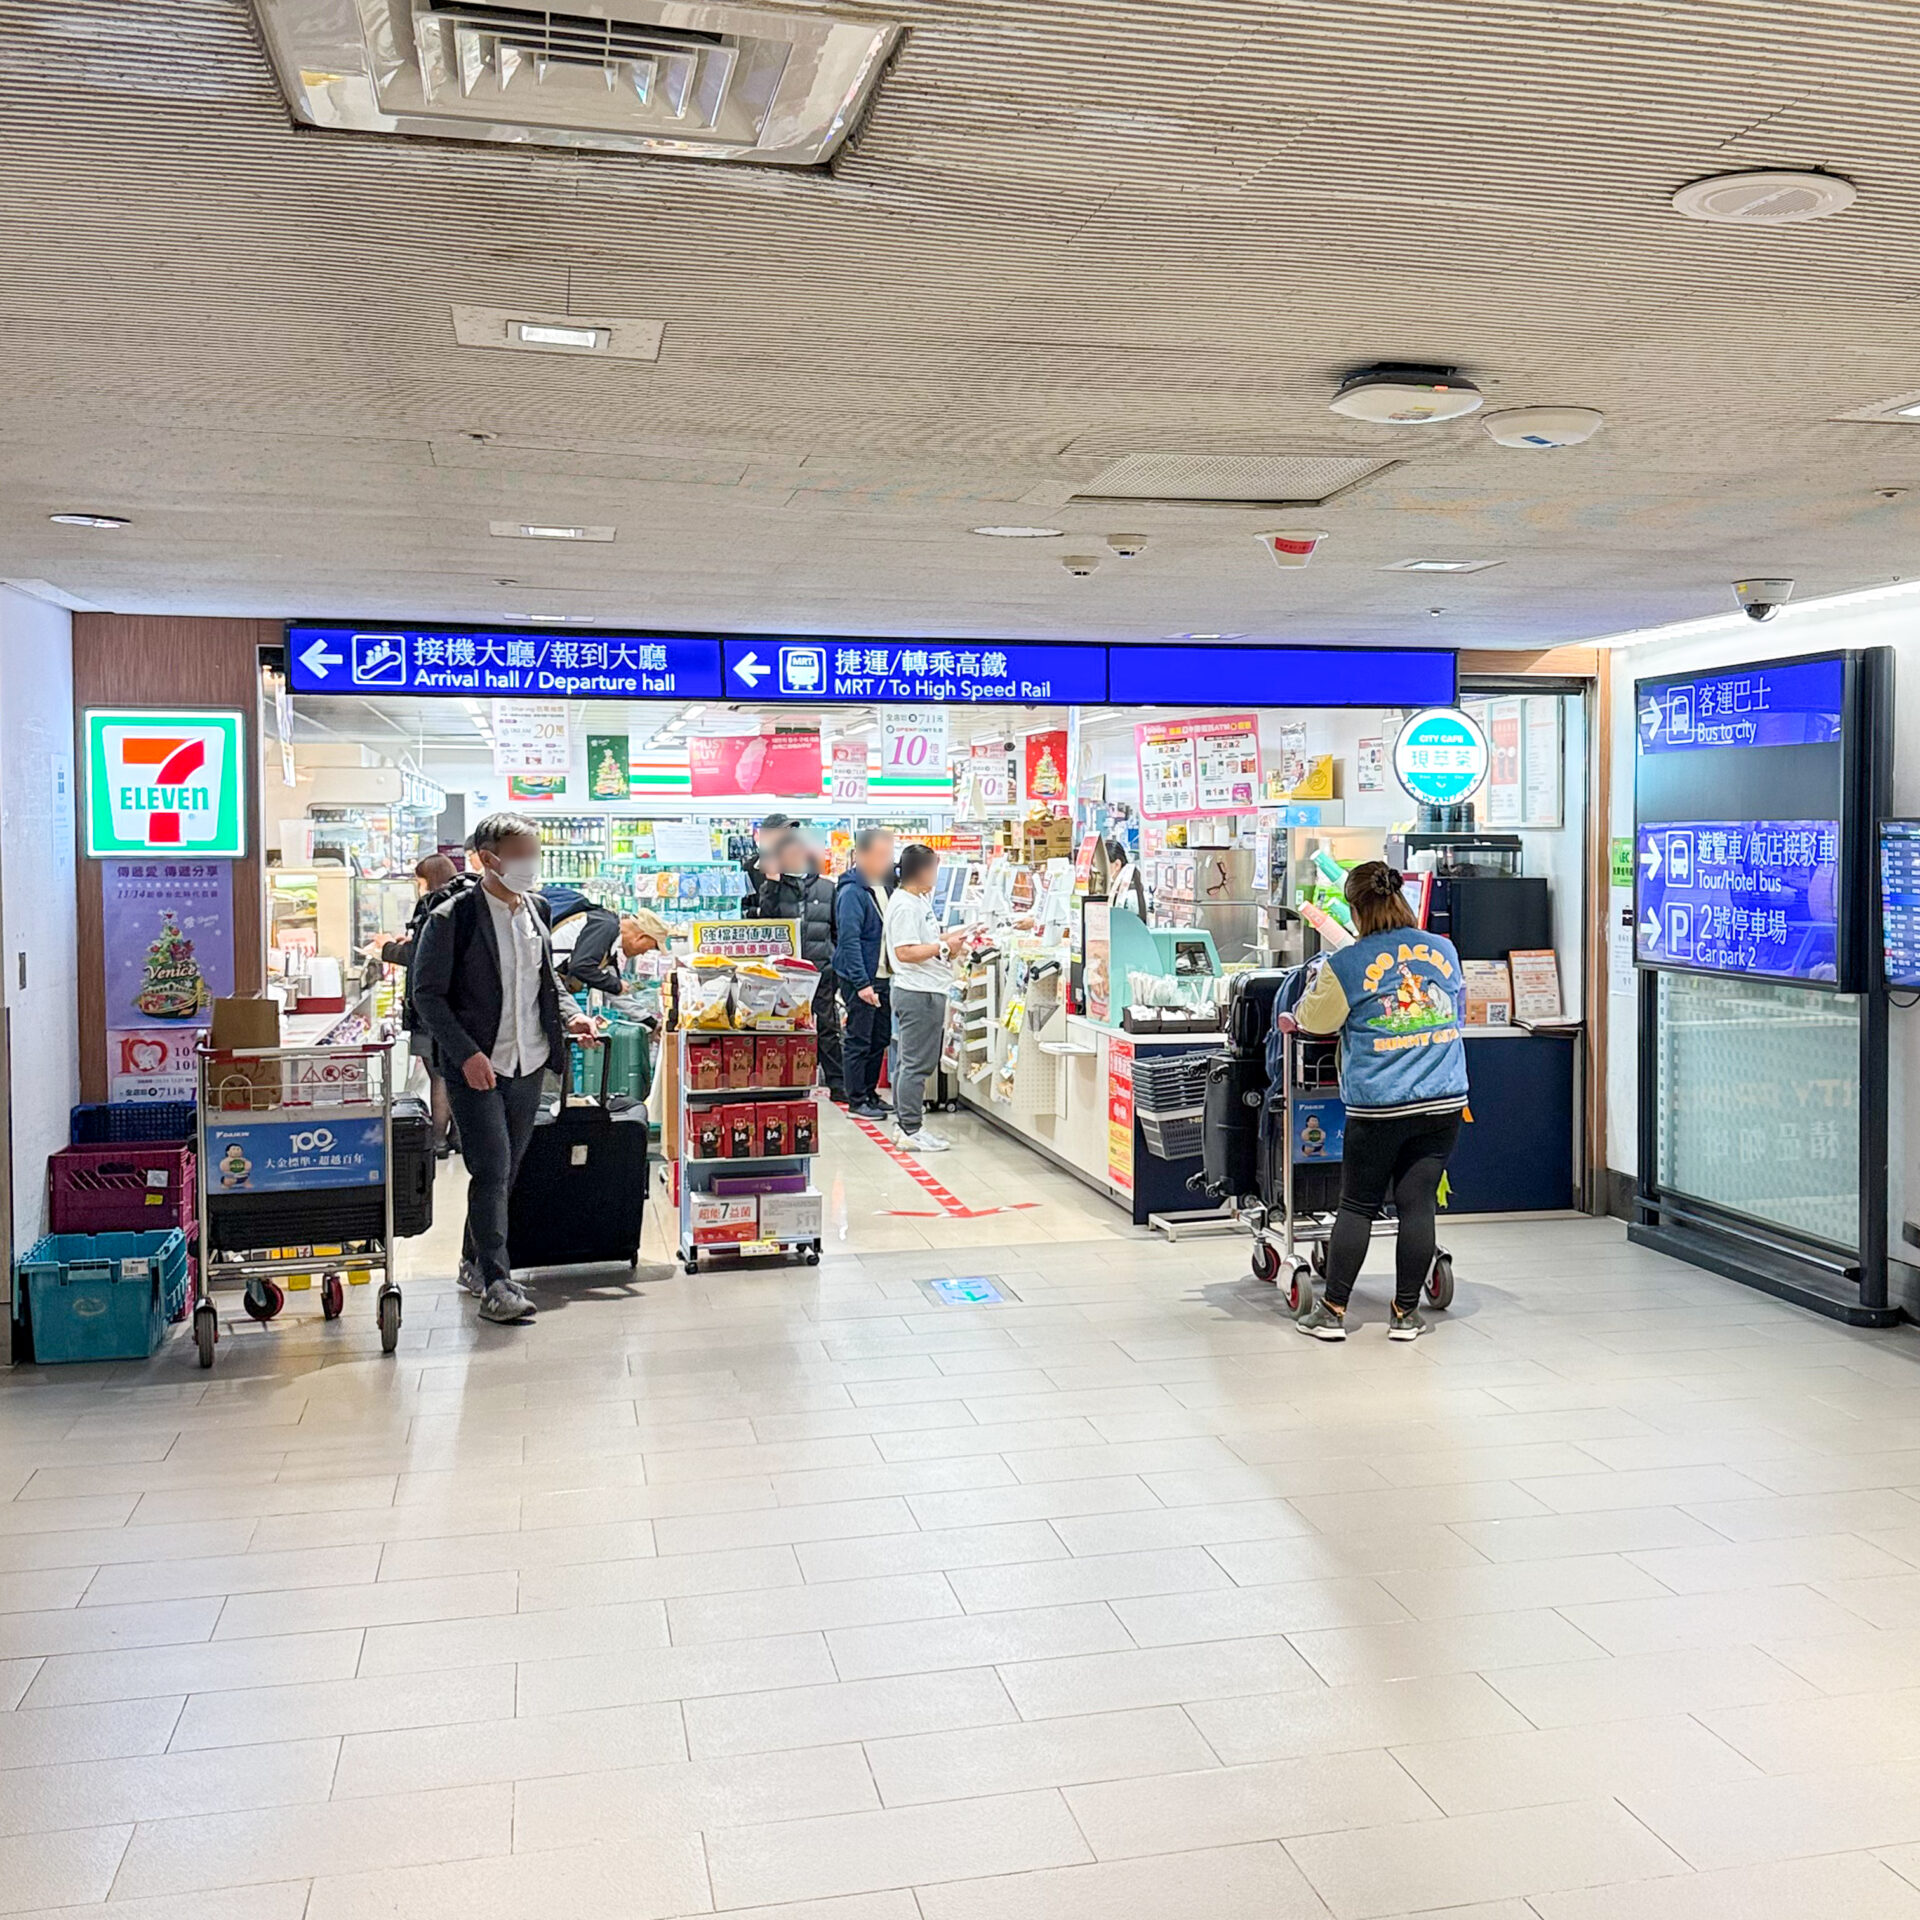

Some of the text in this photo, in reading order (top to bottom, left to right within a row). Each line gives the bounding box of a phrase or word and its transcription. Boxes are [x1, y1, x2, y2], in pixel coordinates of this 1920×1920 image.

[413, 638, 668, 671] 接機大廳/報到大廳
[835, 648, 1008, 677] 捷運/轉乘高鐵
[414, 668, 478, 687] Arrival
[486, 670, 519, 688] hall
[538, 672, 636, 693] Departure
[642, 673, 675, 692] hall
[835, 679, 874, 695] MRT
[889, 680, 911, 697] To
[916, 680, 956, 700] High
[960, 681, 1016, 701] Speed
[1021, 681, 1051, 698] Rail
[1698, 677, 1772, 717] 客運巴士
[1418, 735, 1464, 743] CITY CAFE
[1697, 719, 1757, 744] Bus to city
[888, 735, 928, 766] 10
[1412, 750, 1472, 768] 現萃茶
[122, 737, 205, 842] 7
[1697, 830, 1835, 869] 遊覽車/飯店接駁車
[1697, 869, 1782, 893] Tour/Hotel bus
[703, 926, 787, 941] 強檔超值專區
[1700, 904, 1787, 946] 2號停車場
[701, 943, 791, 955] 好康推薦優惠商品
[1696, 942, 1756, 968] Car park 2
[144, 963, 198, 981] Venice
[1363, 944, 1454, 993] 100 ACRE
[175, 1046, 197, 1057] 10
[289, 1128, 338, 1153] 100
